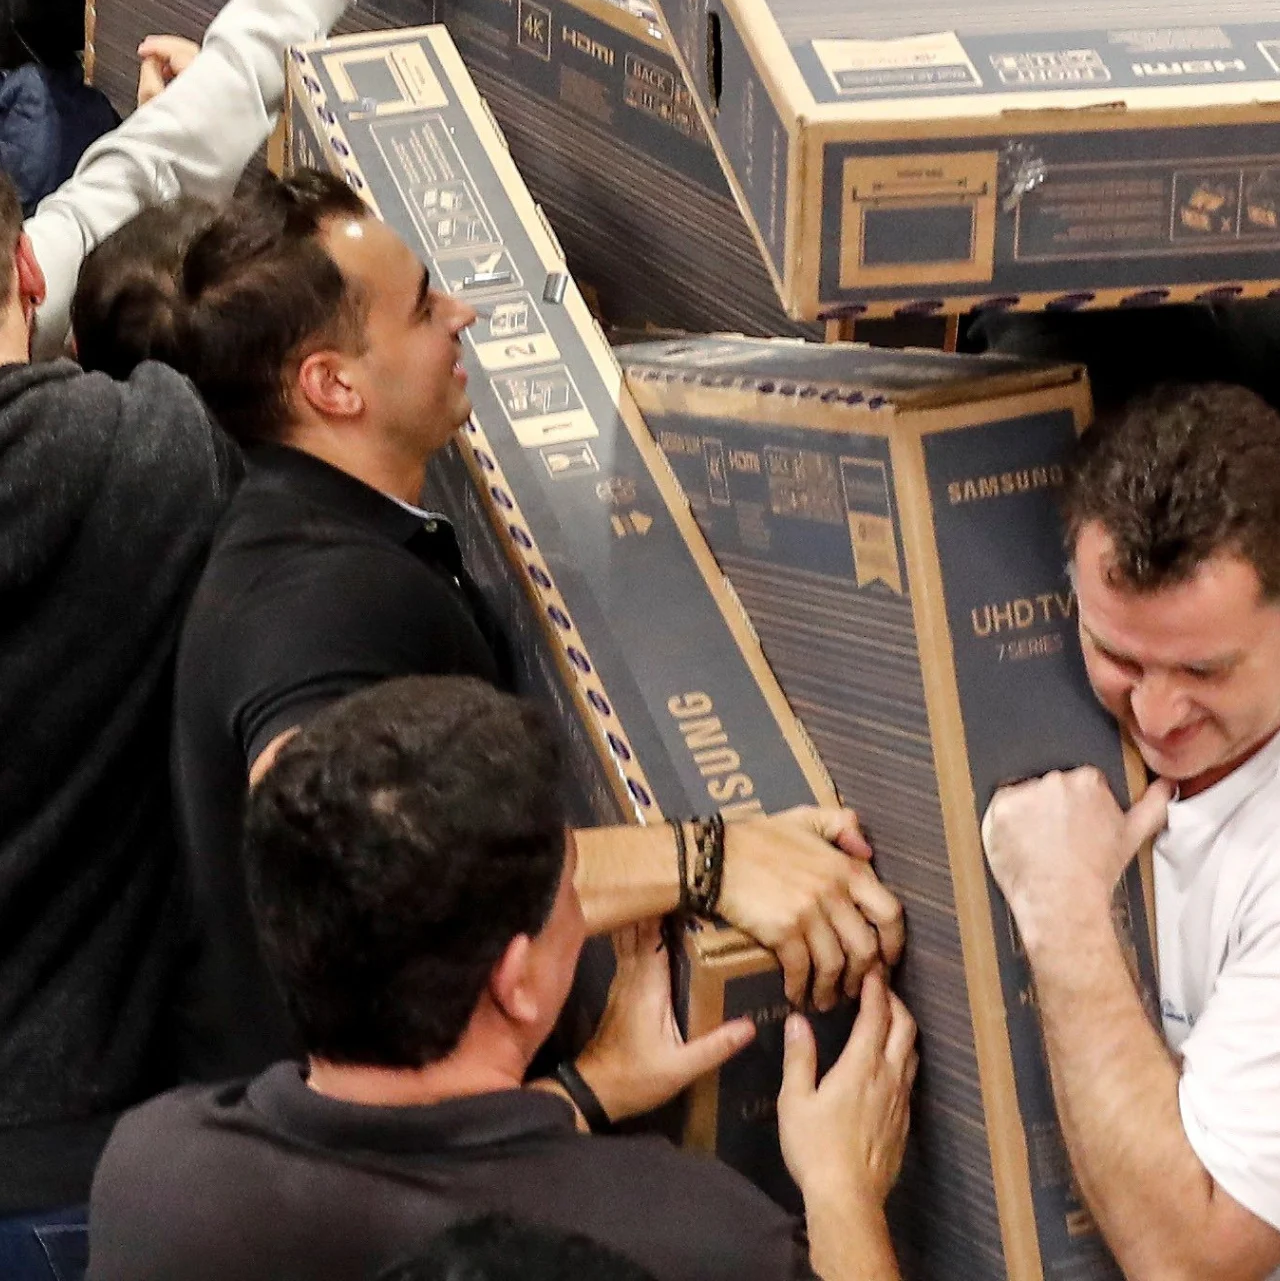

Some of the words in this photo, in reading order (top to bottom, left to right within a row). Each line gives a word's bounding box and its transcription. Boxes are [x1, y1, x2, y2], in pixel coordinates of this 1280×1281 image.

[523, 10, 547, 43] 4K
[970, 600, 1036, 638] UHD
[1008, 632, 1065, 660] SERIES
[666, 690, 766, 818] SUNG
